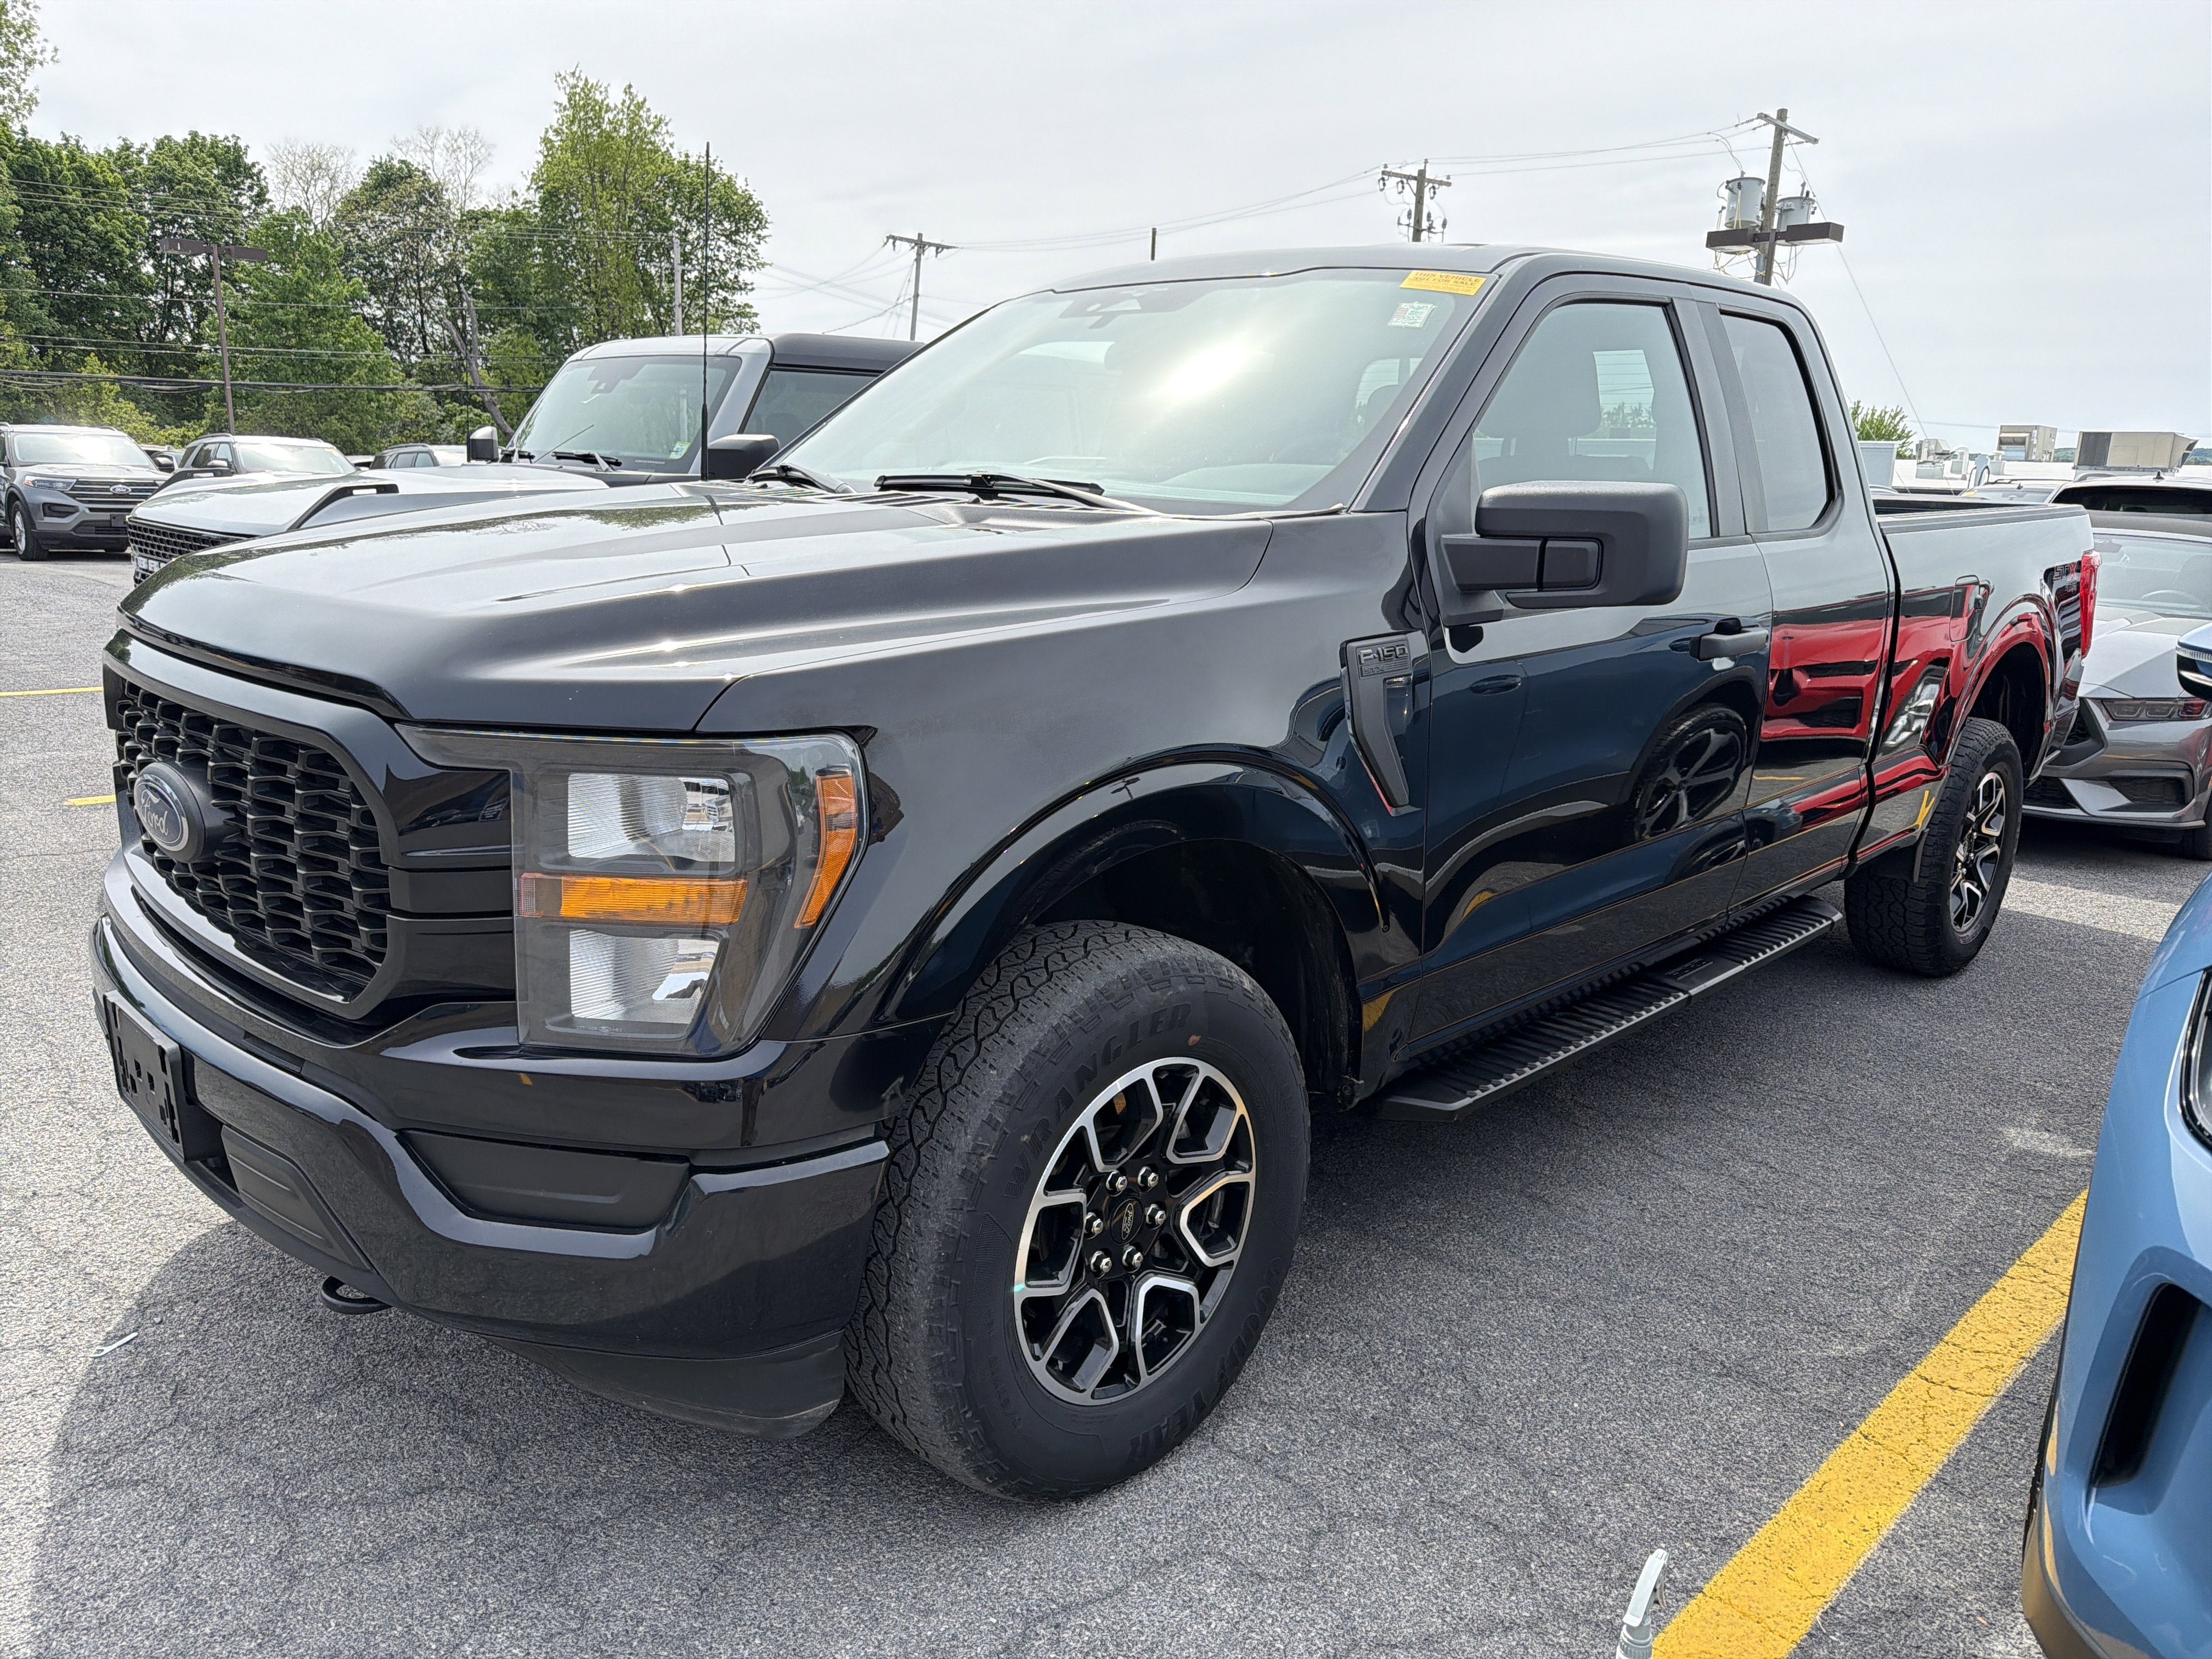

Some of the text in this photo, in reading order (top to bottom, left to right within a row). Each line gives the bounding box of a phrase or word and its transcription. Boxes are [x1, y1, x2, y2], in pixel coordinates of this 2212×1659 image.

[1439, 274, 1480, 283] VEHICLE
[2053, 562, 2077, 580] STX
[1359, 645, 1409, 664] F-150
[1364, 665, 1385, 674] STX
[141, 789, 168, 836] Ford
[1003, 1002, 1192, 1199] WRANGLER
[1122, 1210, 1133, 1234] Ford
